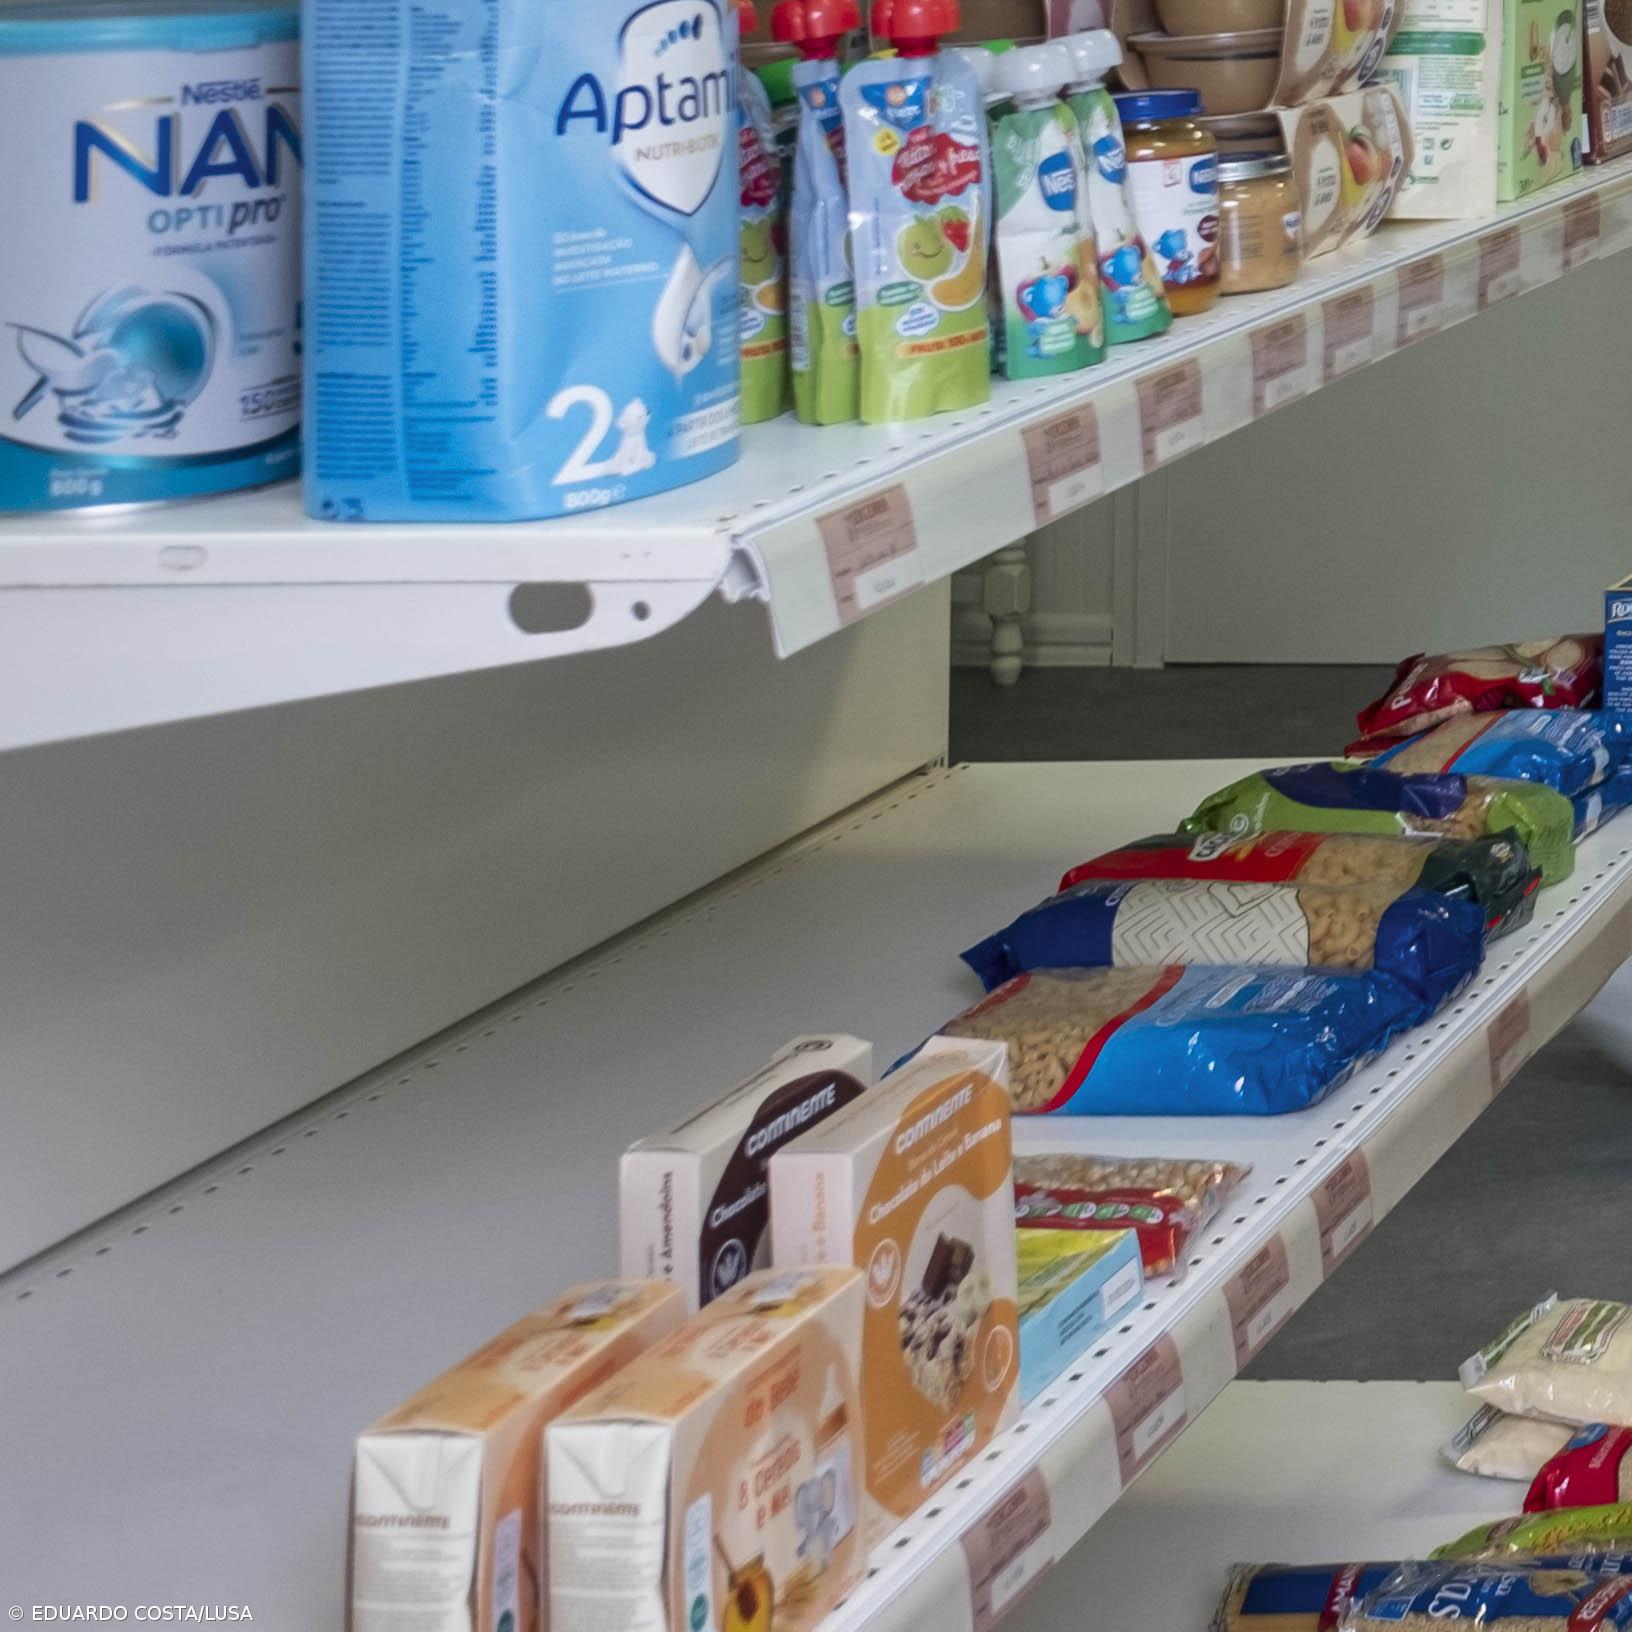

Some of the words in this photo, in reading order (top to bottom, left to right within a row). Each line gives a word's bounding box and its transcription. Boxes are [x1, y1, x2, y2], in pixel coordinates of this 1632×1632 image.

[180, 77, 264, 106] Nestlé
[1040, 173, 1076, 196] Nes
[546, 384, 628, 486] 2
[743, 1081, 838, 1158] CONTINENTE
[895, 1081, 976, 1156] CONTINENTE
